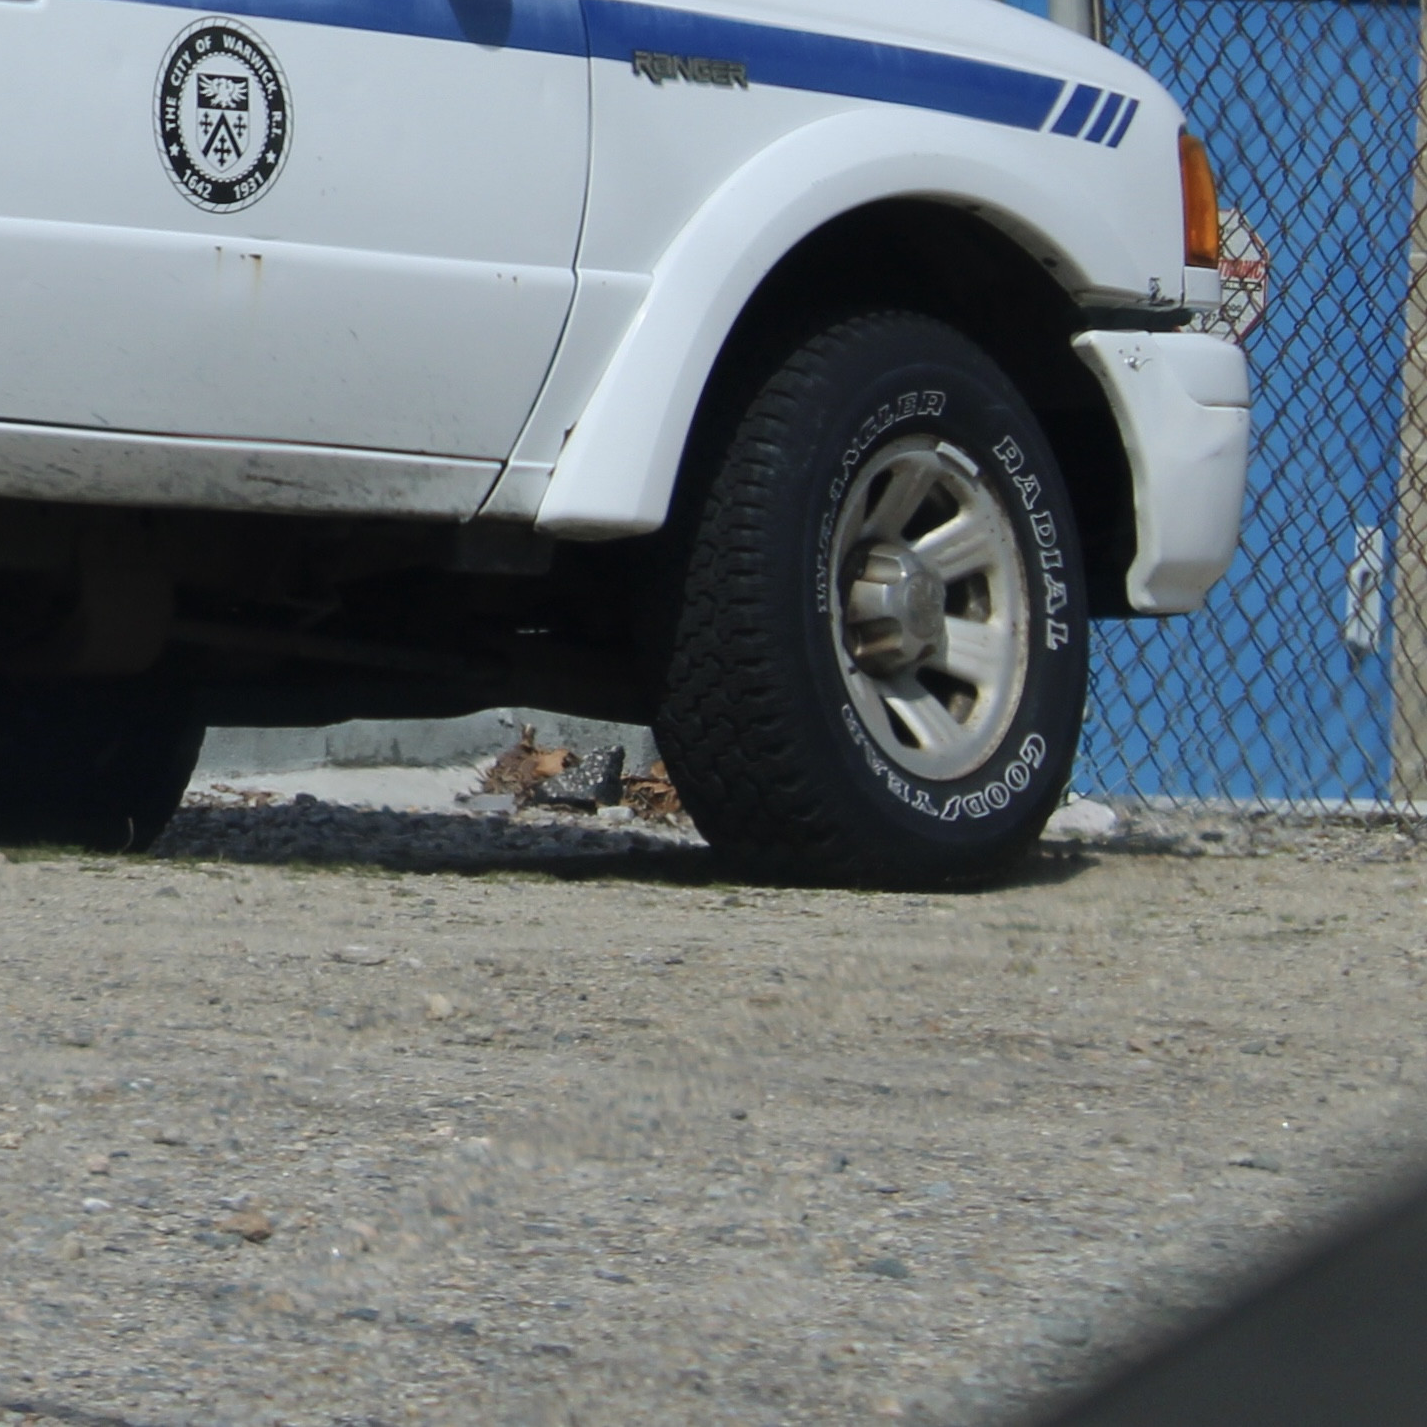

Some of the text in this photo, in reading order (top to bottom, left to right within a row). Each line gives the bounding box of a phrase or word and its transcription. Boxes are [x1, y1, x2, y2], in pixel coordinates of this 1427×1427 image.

[164, 95, 177, 132] THE
[171, 50, 193, 87] CITY
[196, 35, 213, 52] OF
[632, 49, 749, 90] RANGER
[182, 169, 264, 200] 1642 1931
[993, 435, 1069, 651] RADIAL
